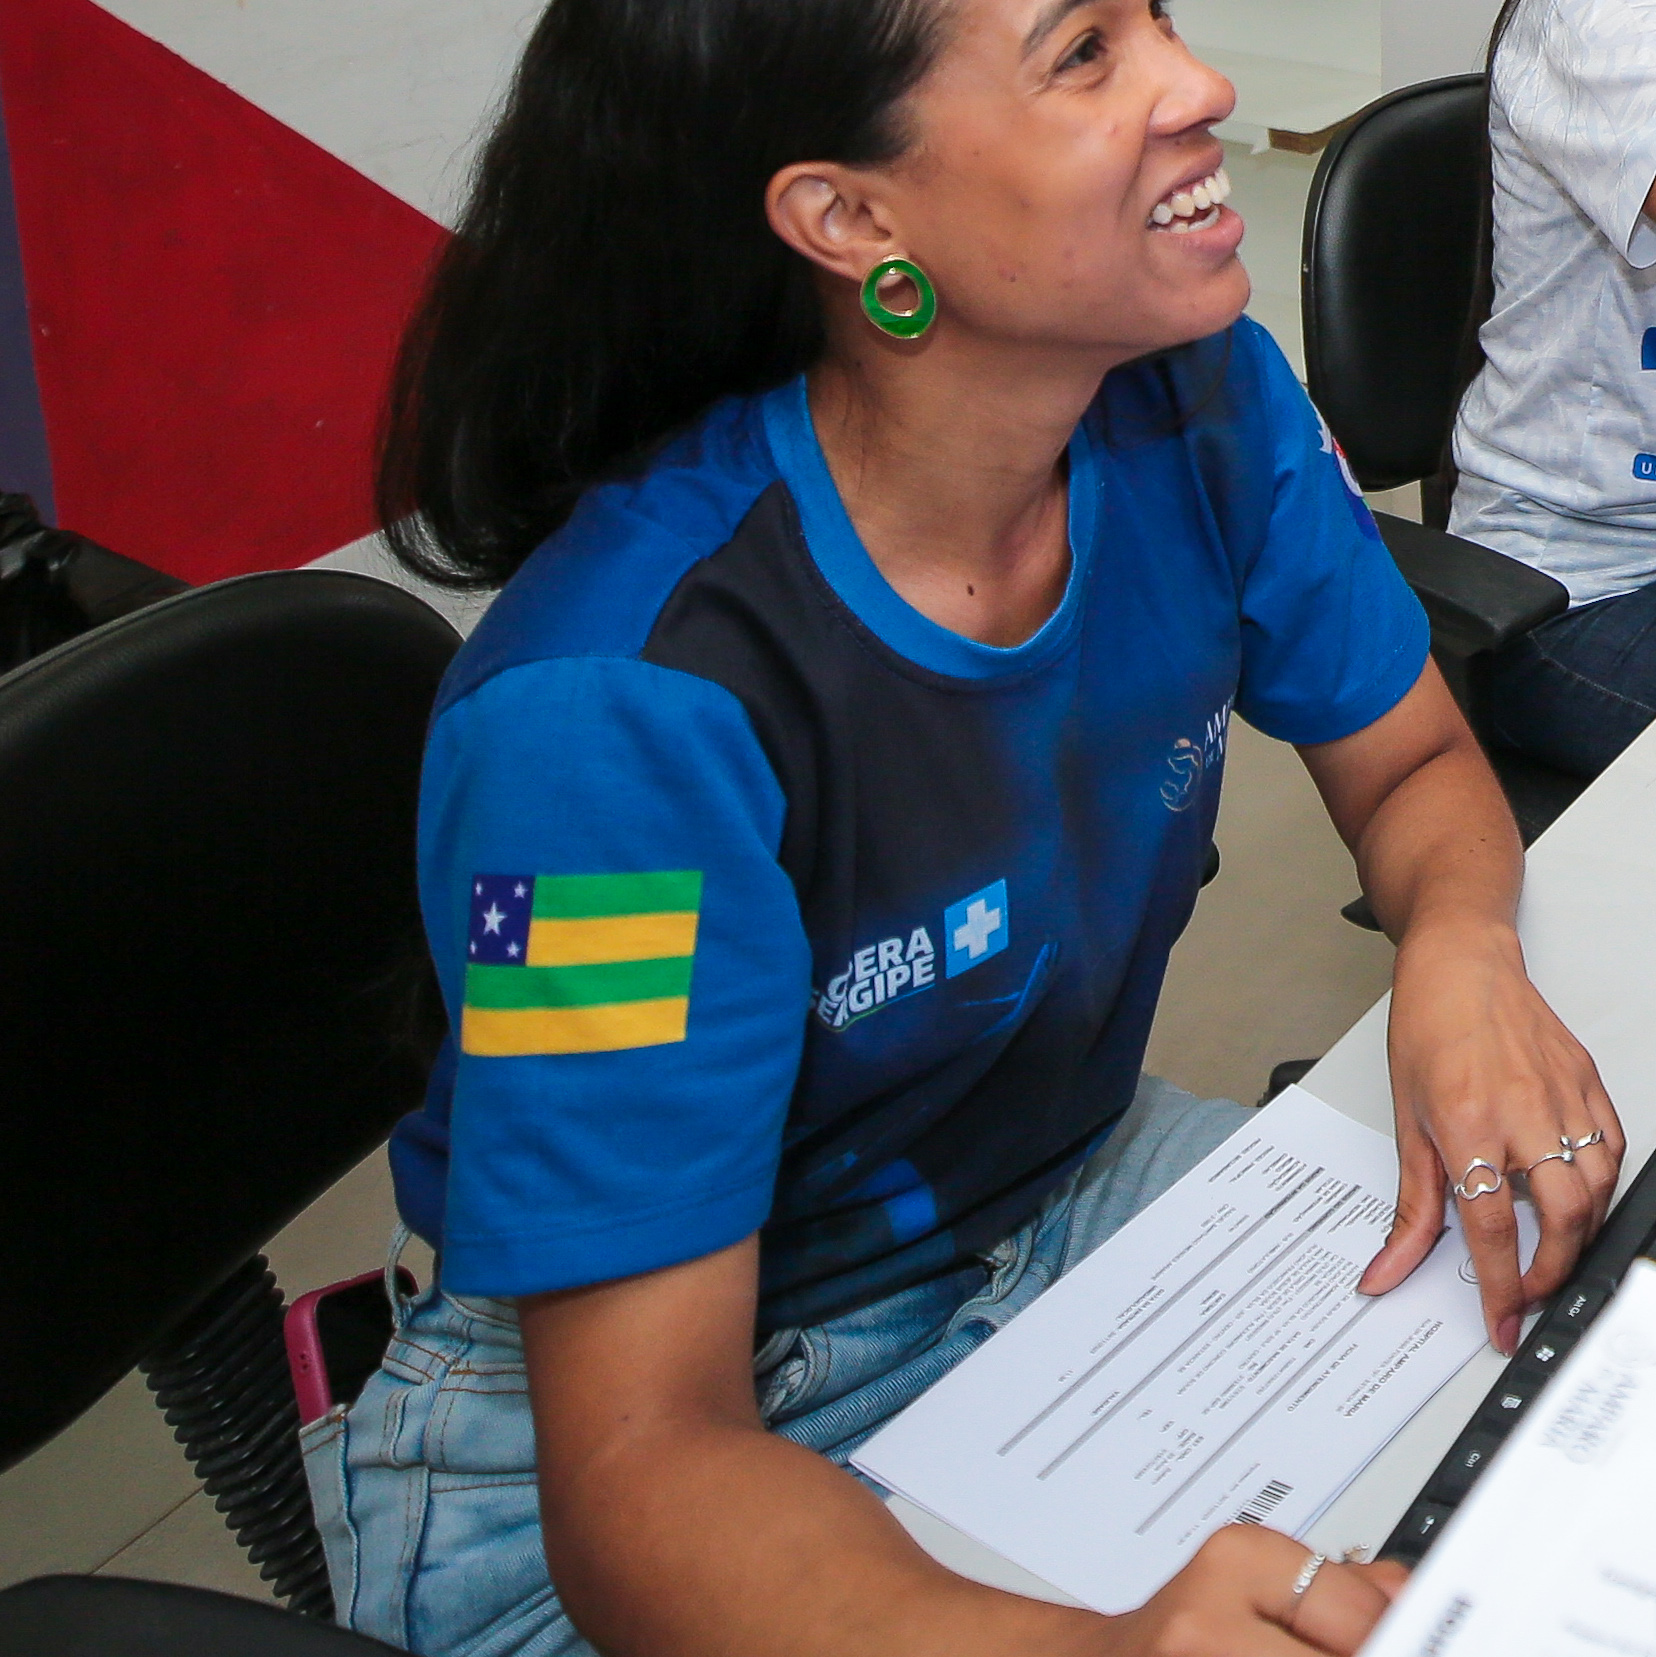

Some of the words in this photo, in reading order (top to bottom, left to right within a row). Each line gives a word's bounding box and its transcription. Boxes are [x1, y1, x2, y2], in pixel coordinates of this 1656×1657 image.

[1407, 1320, 1444, 1354] HOSPITAL
[1336, 1343, 1358, 1362] FICHA
[1377, 1352, 1411, 1384] AMPARO
[1285, 1369, 1332, 1413] ATENDIMENTO
[1367, 1383, 1381, 1394] DE
[1343, 1393, 1371, 1418] MARIA
[1565, 1367, 1640, 1466] AMPARO
[1465, 1451, 1482, 1469] Ctrl
